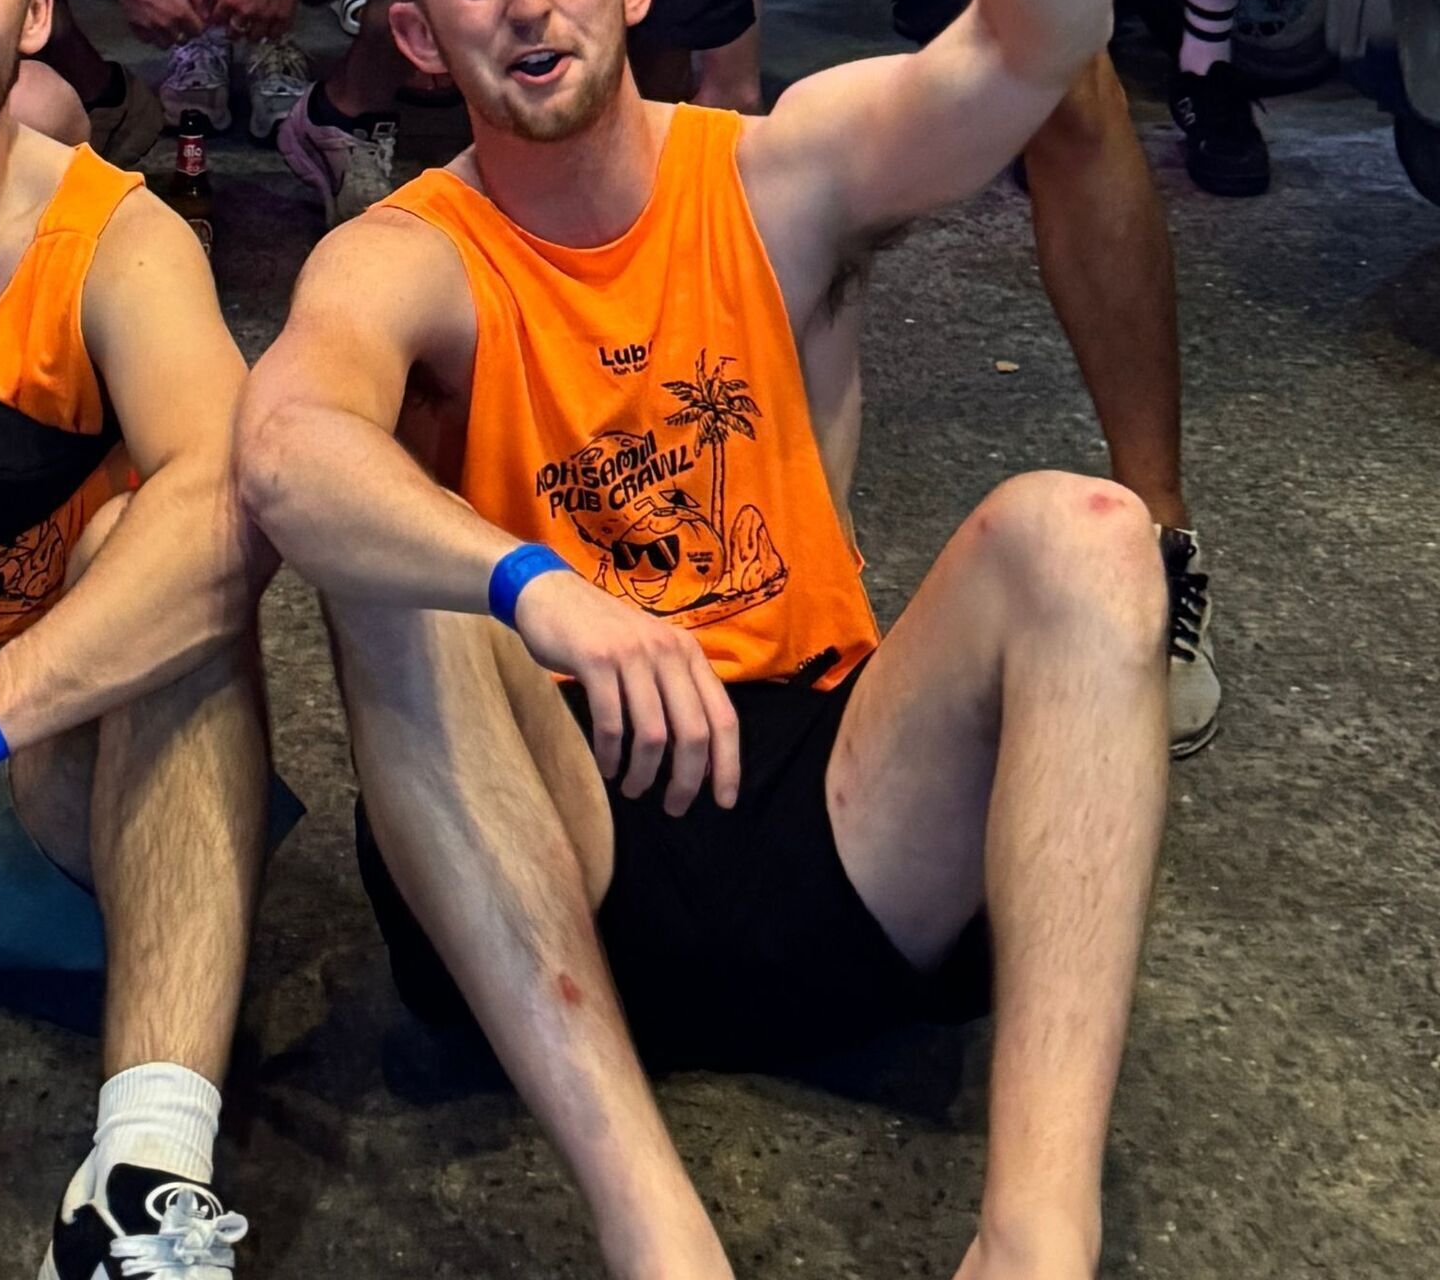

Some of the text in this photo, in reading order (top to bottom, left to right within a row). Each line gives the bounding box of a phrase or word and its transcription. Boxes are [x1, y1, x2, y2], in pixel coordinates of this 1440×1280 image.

[599, 344, 647, 366] Lub
[550, 445, 694, 519] PUB CRAWL
